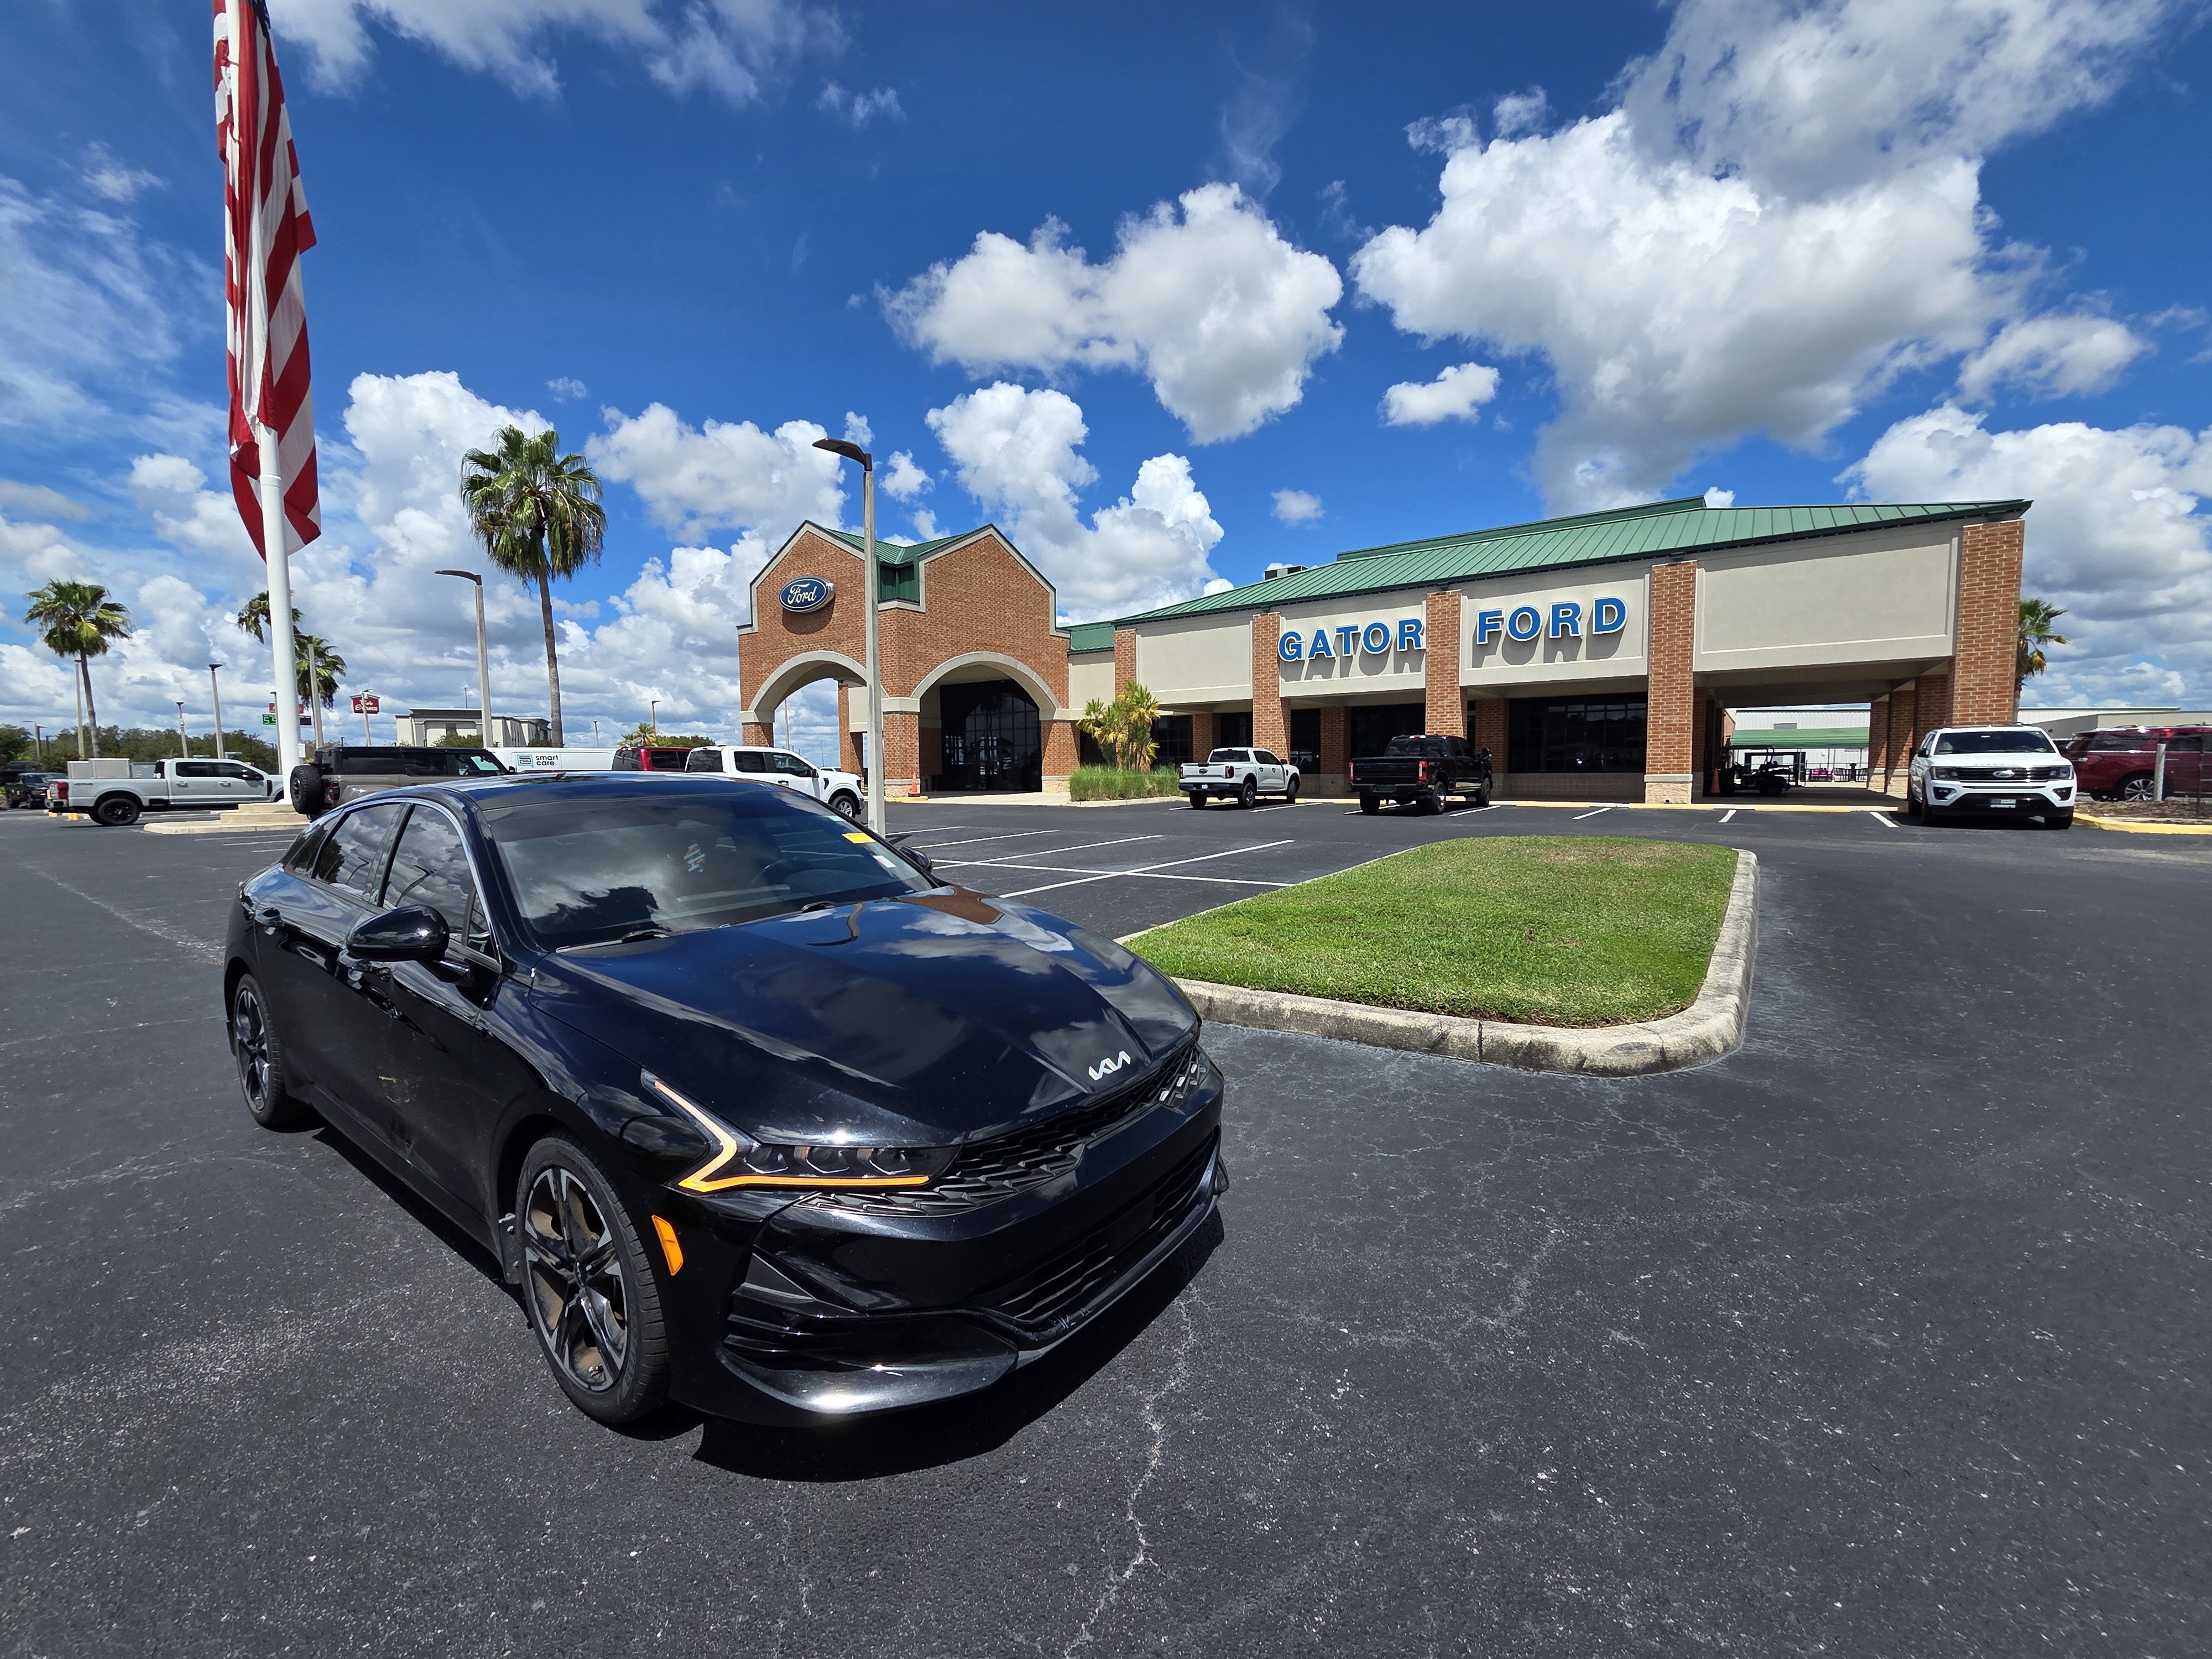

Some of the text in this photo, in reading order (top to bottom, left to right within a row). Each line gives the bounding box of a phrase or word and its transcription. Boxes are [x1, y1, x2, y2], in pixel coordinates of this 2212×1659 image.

[787, 583, 817, 604] Ford
[1278, 596, 1628, 662] GATOR FORD
[1088, 1051, 1131, 1081] KIA
